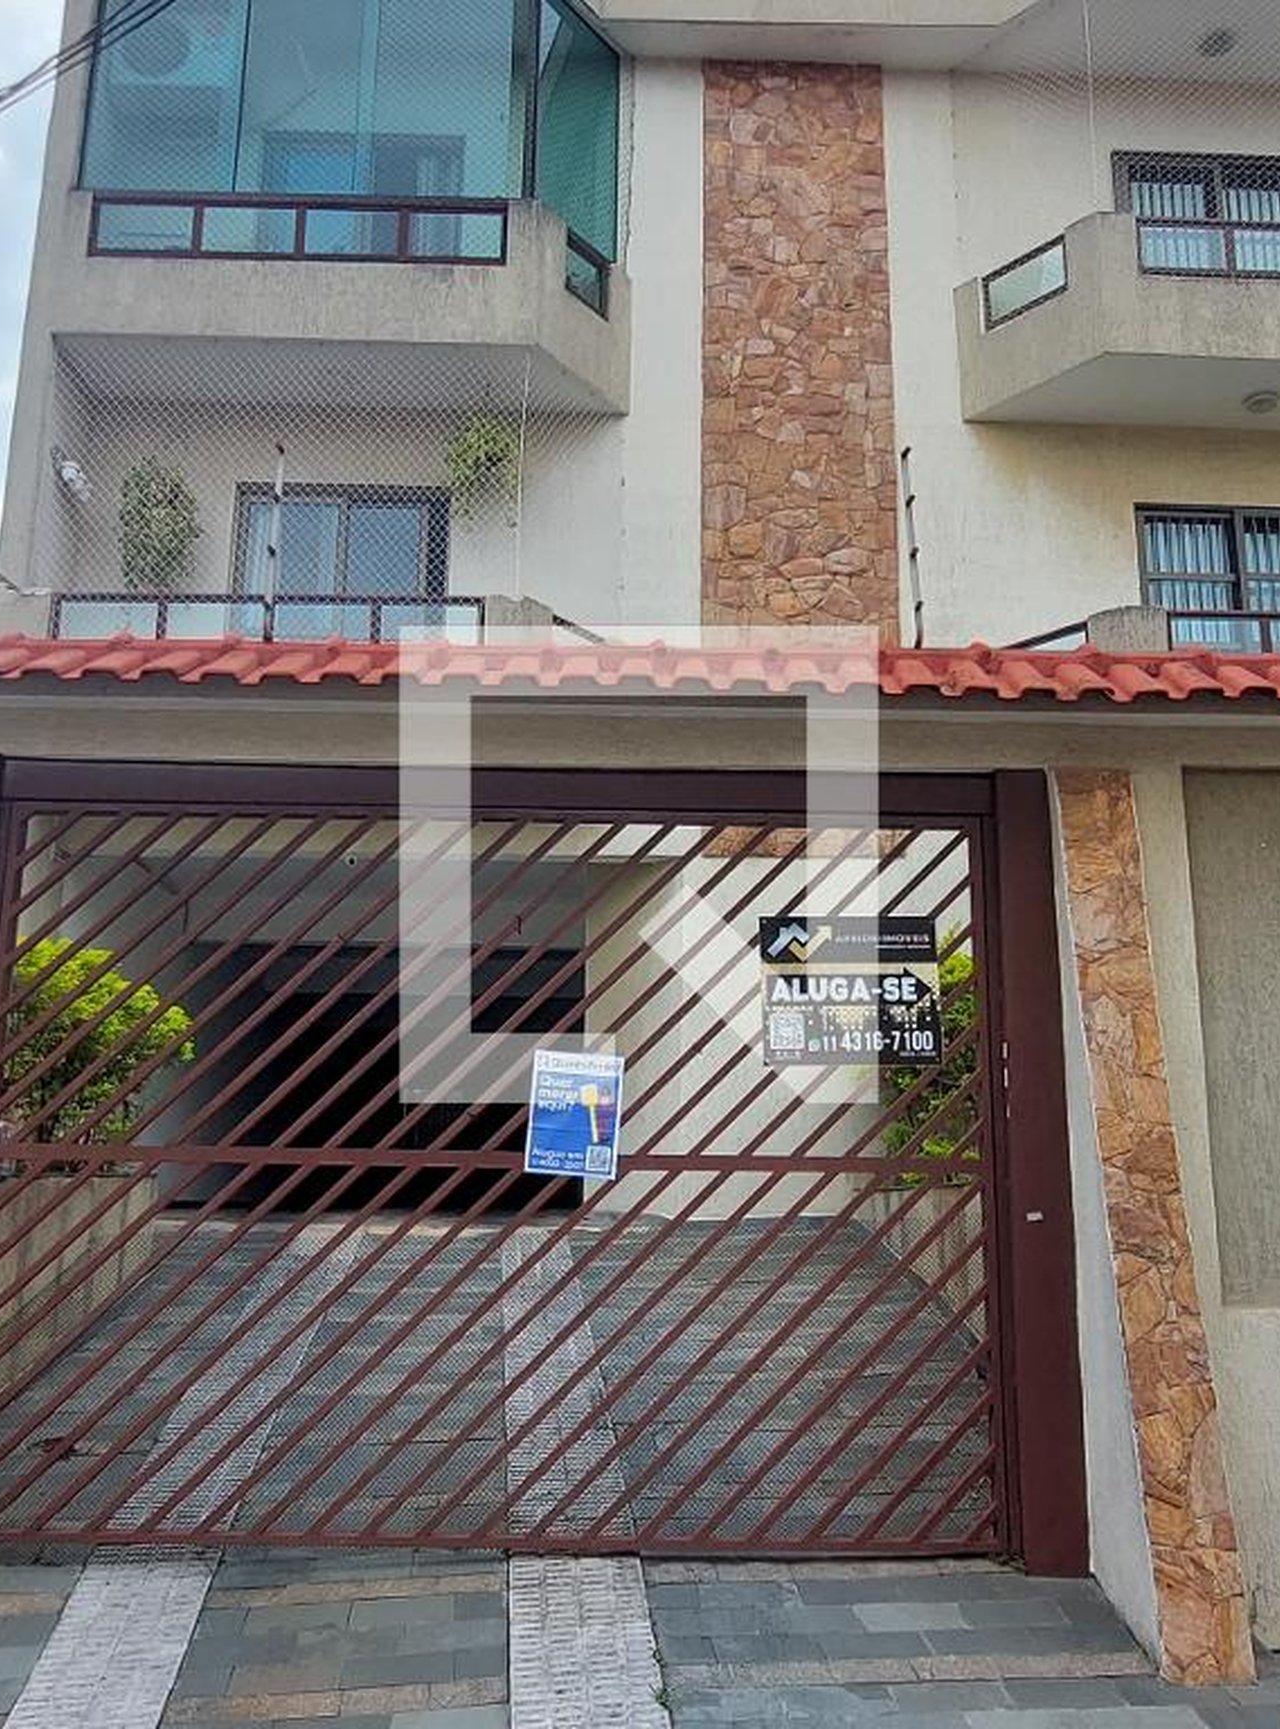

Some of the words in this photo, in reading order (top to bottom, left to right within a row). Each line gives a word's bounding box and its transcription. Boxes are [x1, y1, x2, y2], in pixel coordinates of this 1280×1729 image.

[770, 976, 918, 1002] ALUGA-SE
[822, 1035, 838, 1051] 11
[840, 1030, 934, 1052] 4316-7100
